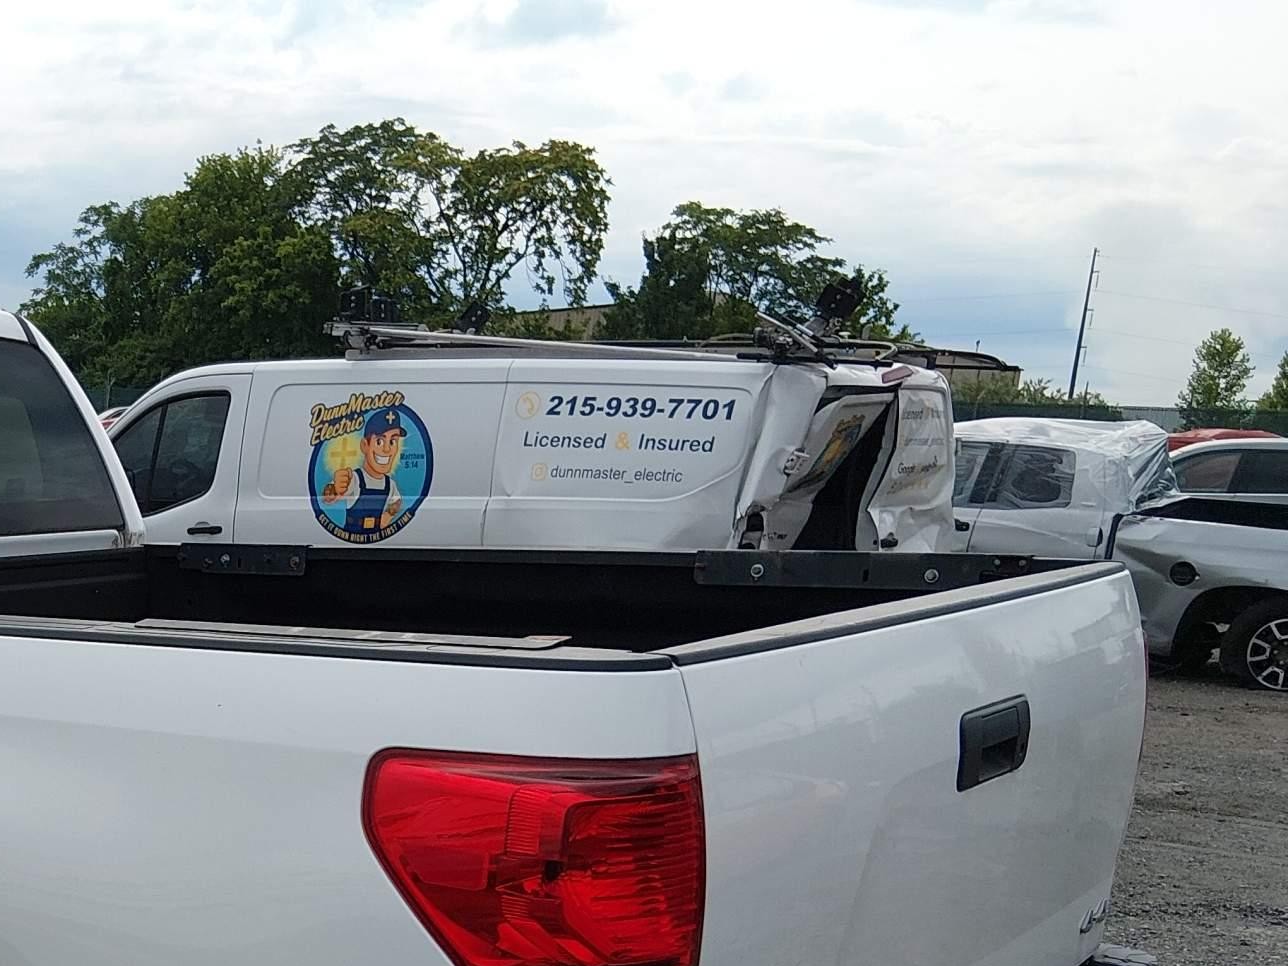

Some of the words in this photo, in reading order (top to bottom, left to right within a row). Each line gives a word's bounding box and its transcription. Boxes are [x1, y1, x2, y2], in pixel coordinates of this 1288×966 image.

[545, 395, 736, 421] 215-939-7701
[311, 413, 364, 446] Electric
[523, 431, 607, 449] Licensed
[615, 431, 630, 450] &
[638, 433, 715, 452] Insured
[550, 465, 683, 483] dunnmaster_electric
